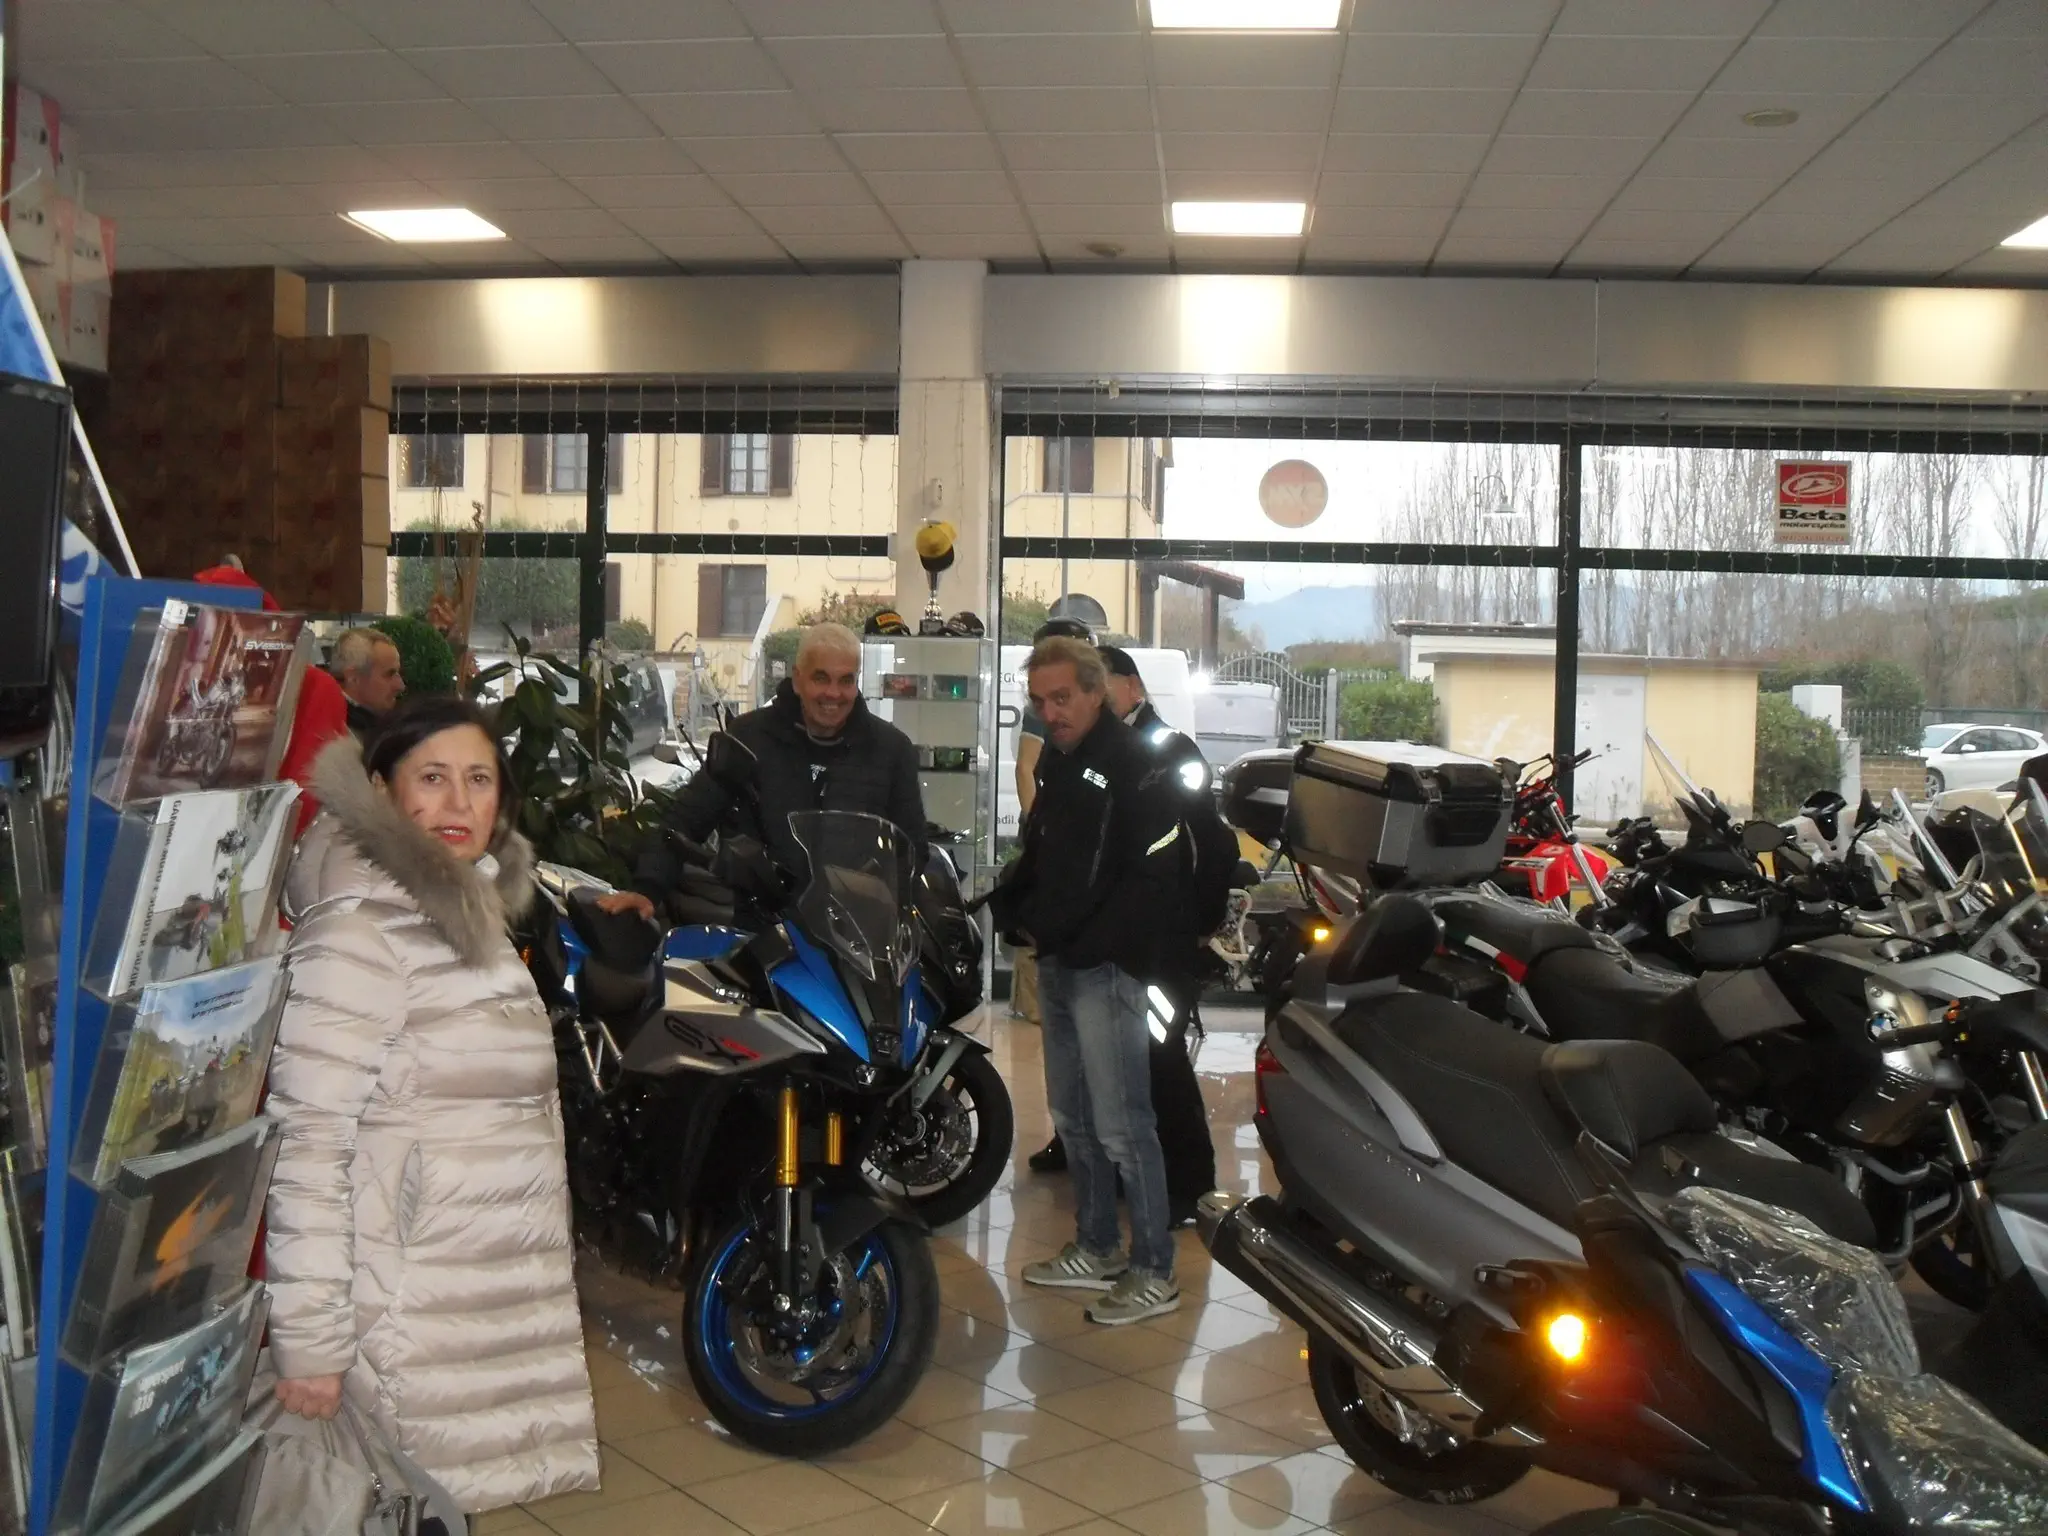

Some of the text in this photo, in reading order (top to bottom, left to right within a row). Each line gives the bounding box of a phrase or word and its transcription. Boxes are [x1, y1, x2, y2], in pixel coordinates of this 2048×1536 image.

[1779, 508, 1847, 521] Beta
[1779, 521, 1847, 530] motorcycles
[129, 950, 144, 988] SUZUK
